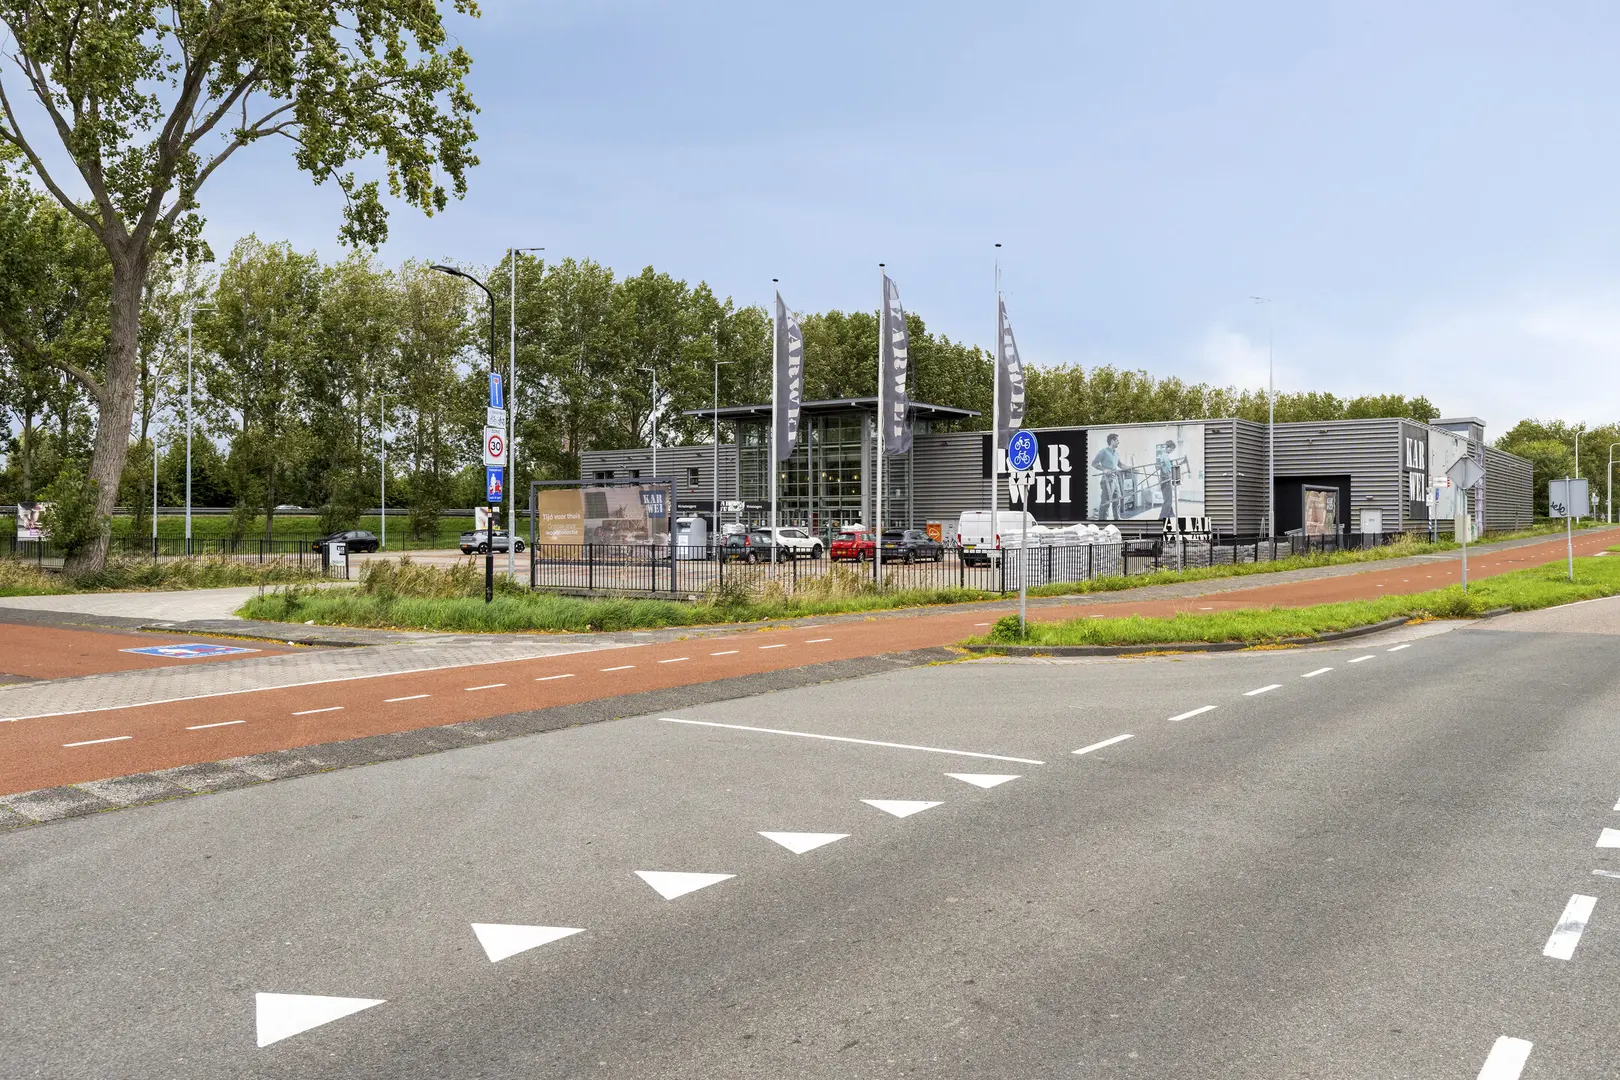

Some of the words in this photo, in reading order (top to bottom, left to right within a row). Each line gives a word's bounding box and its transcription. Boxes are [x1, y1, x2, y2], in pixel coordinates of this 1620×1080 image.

[490, 441, 501, 451] 30
[1406, 437, 1425, 470] KAR
[1410, 472, 1425, 501] WEI
[643, 494, 663, 504] KAR
[647, 503, 663, 513] WEI
[542, 513, 554, 521] Tijd
